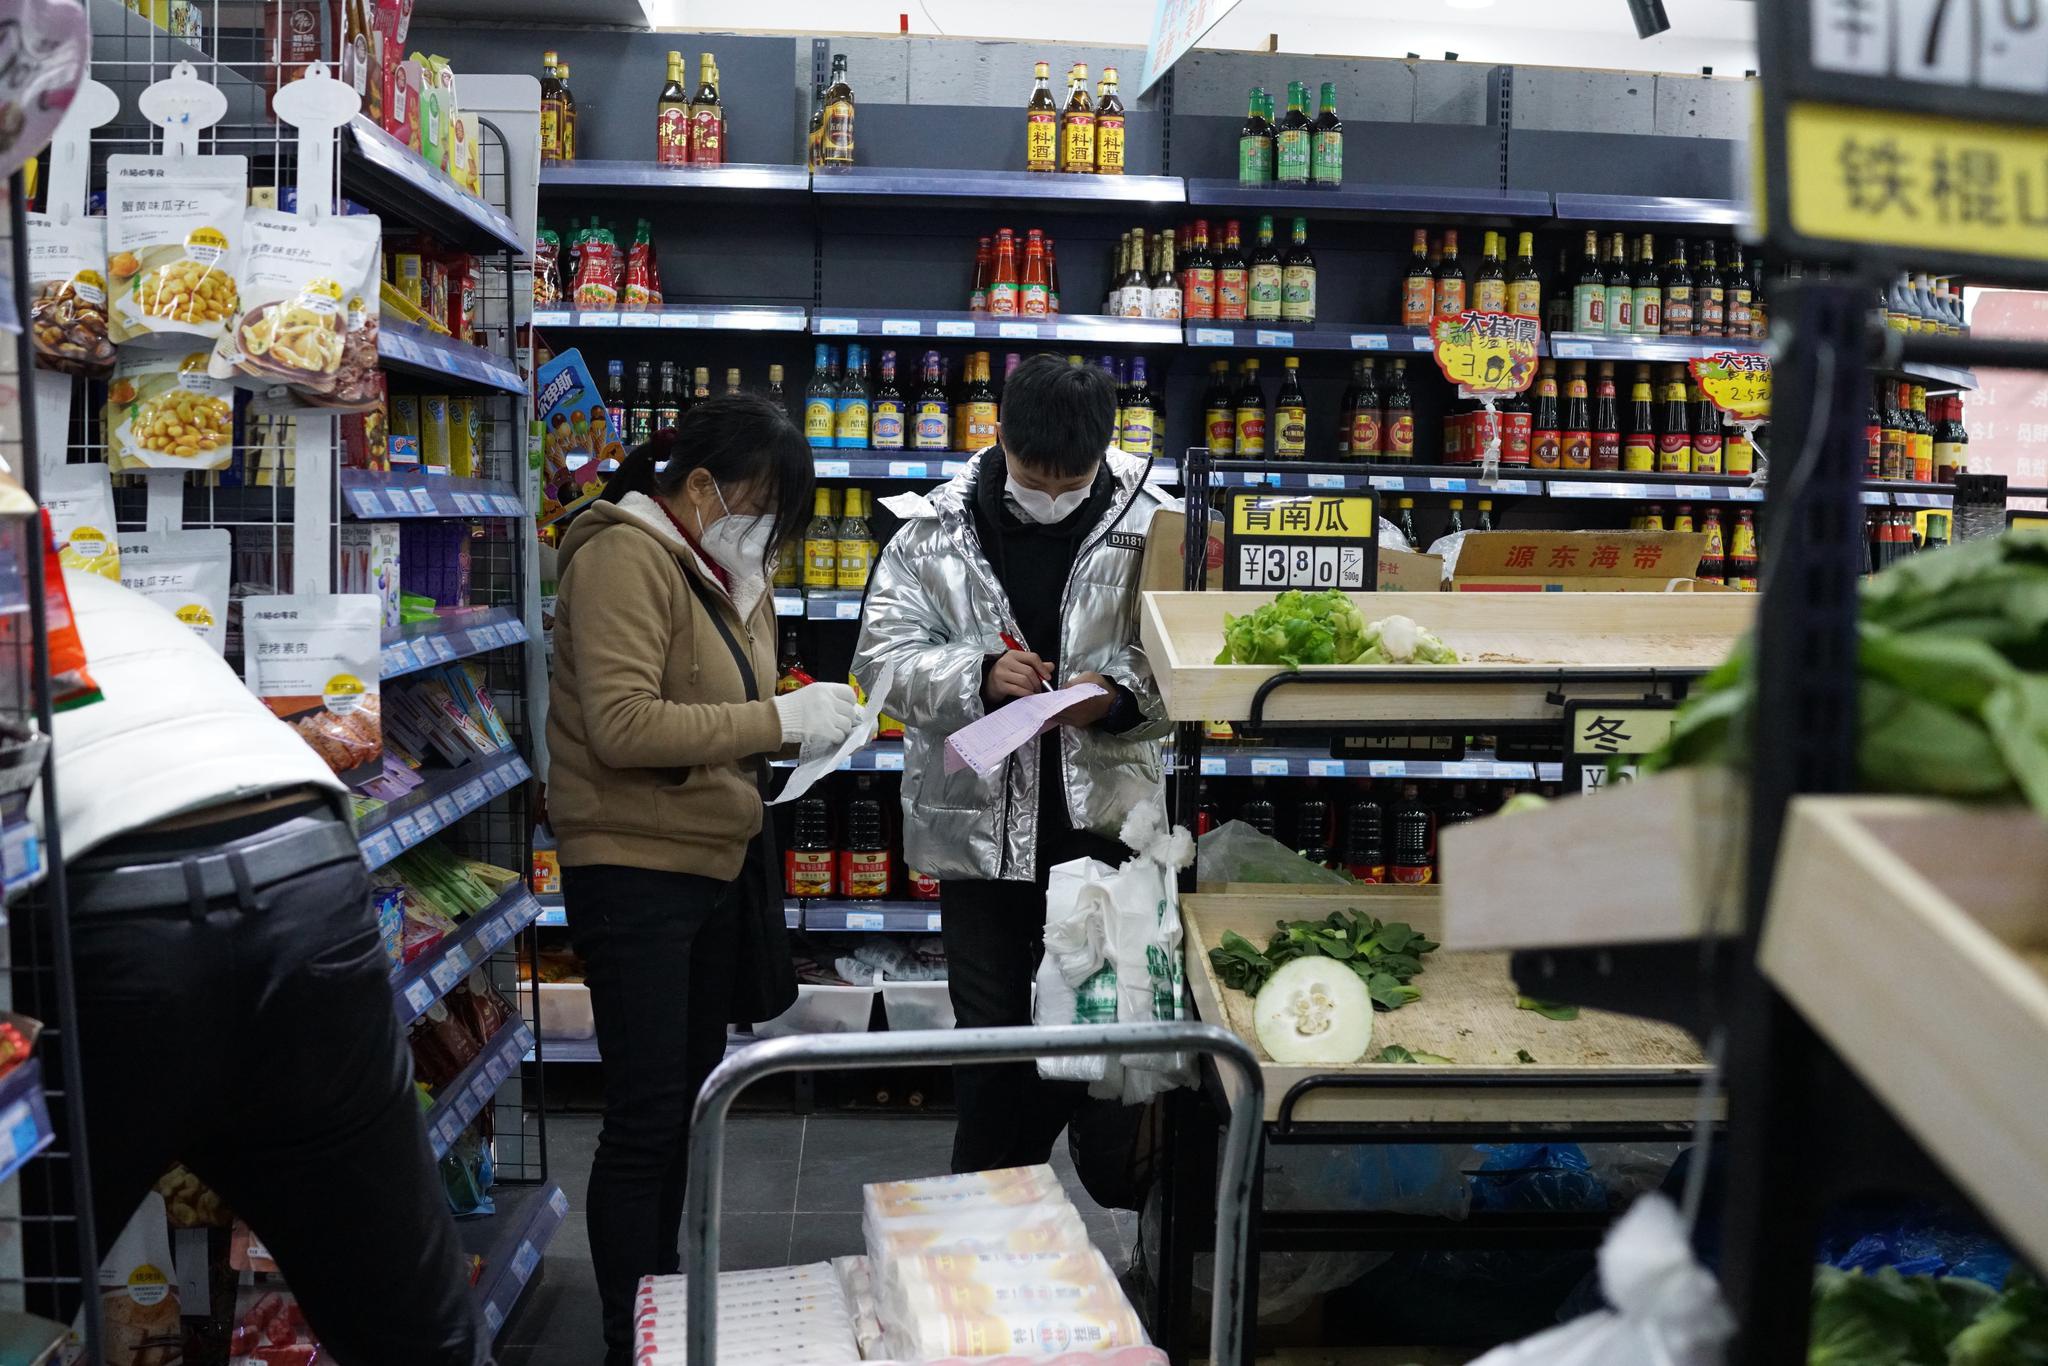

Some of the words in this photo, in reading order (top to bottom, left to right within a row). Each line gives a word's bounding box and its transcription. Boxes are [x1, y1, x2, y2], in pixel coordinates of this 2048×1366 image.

[1033, 131, 1051, 158] 料酒
[1071, 133, 1089, 160] 料酒
[1103, 136, 1121, 164] 料酒
[1461, 312, 1538, 343] 大特價
[1242, 497, 1349, 532] 青南瓜
[1504, 544, 1663, 570] 源东海带
[1583, 715, 1632, 752] 冬
